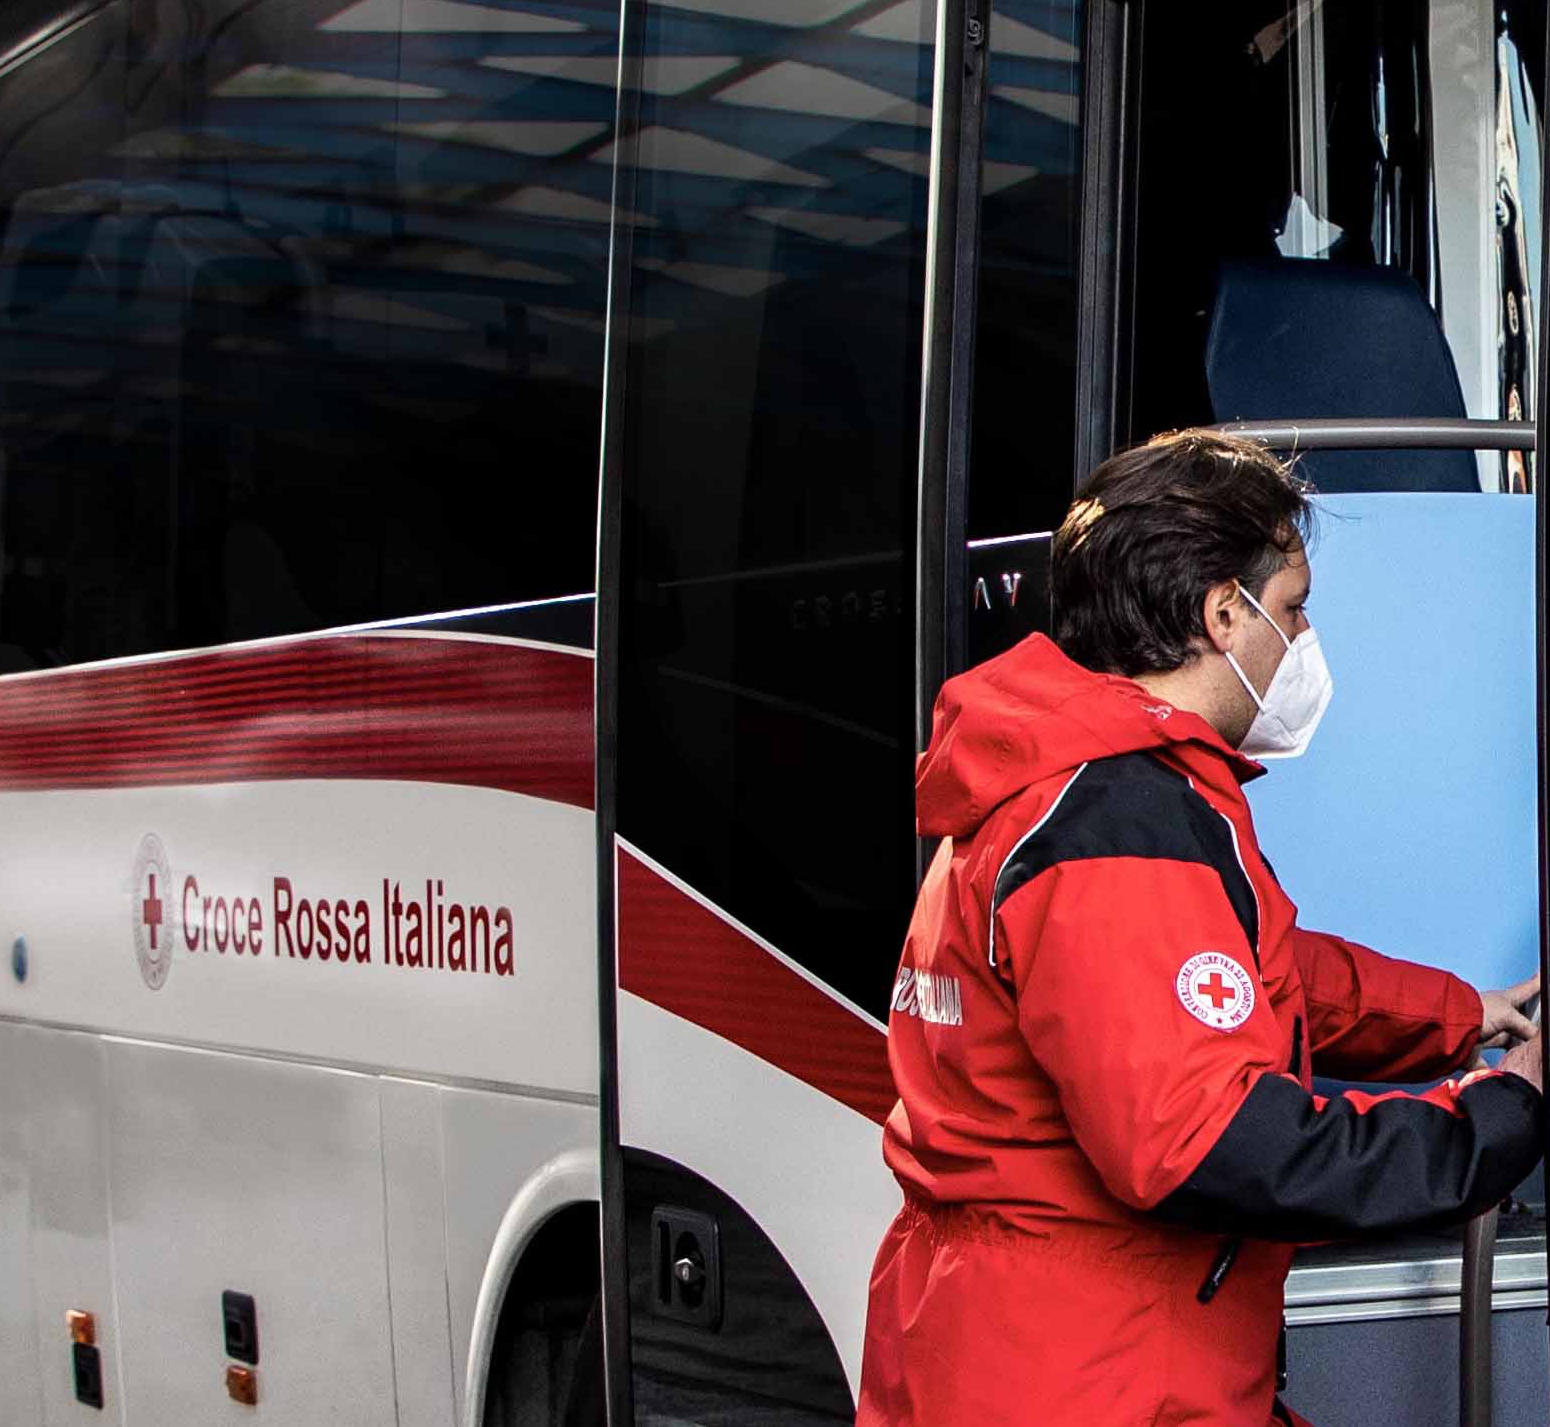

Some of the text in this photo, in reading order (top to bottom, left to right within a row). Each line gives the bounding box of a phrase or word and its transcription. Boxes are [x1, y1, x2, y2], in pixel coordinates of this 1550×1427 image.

[183, 874, 263, 955] Croce
[273, 877, 371, 963] Rossa
[383, 877, 515, 976] Italiana
